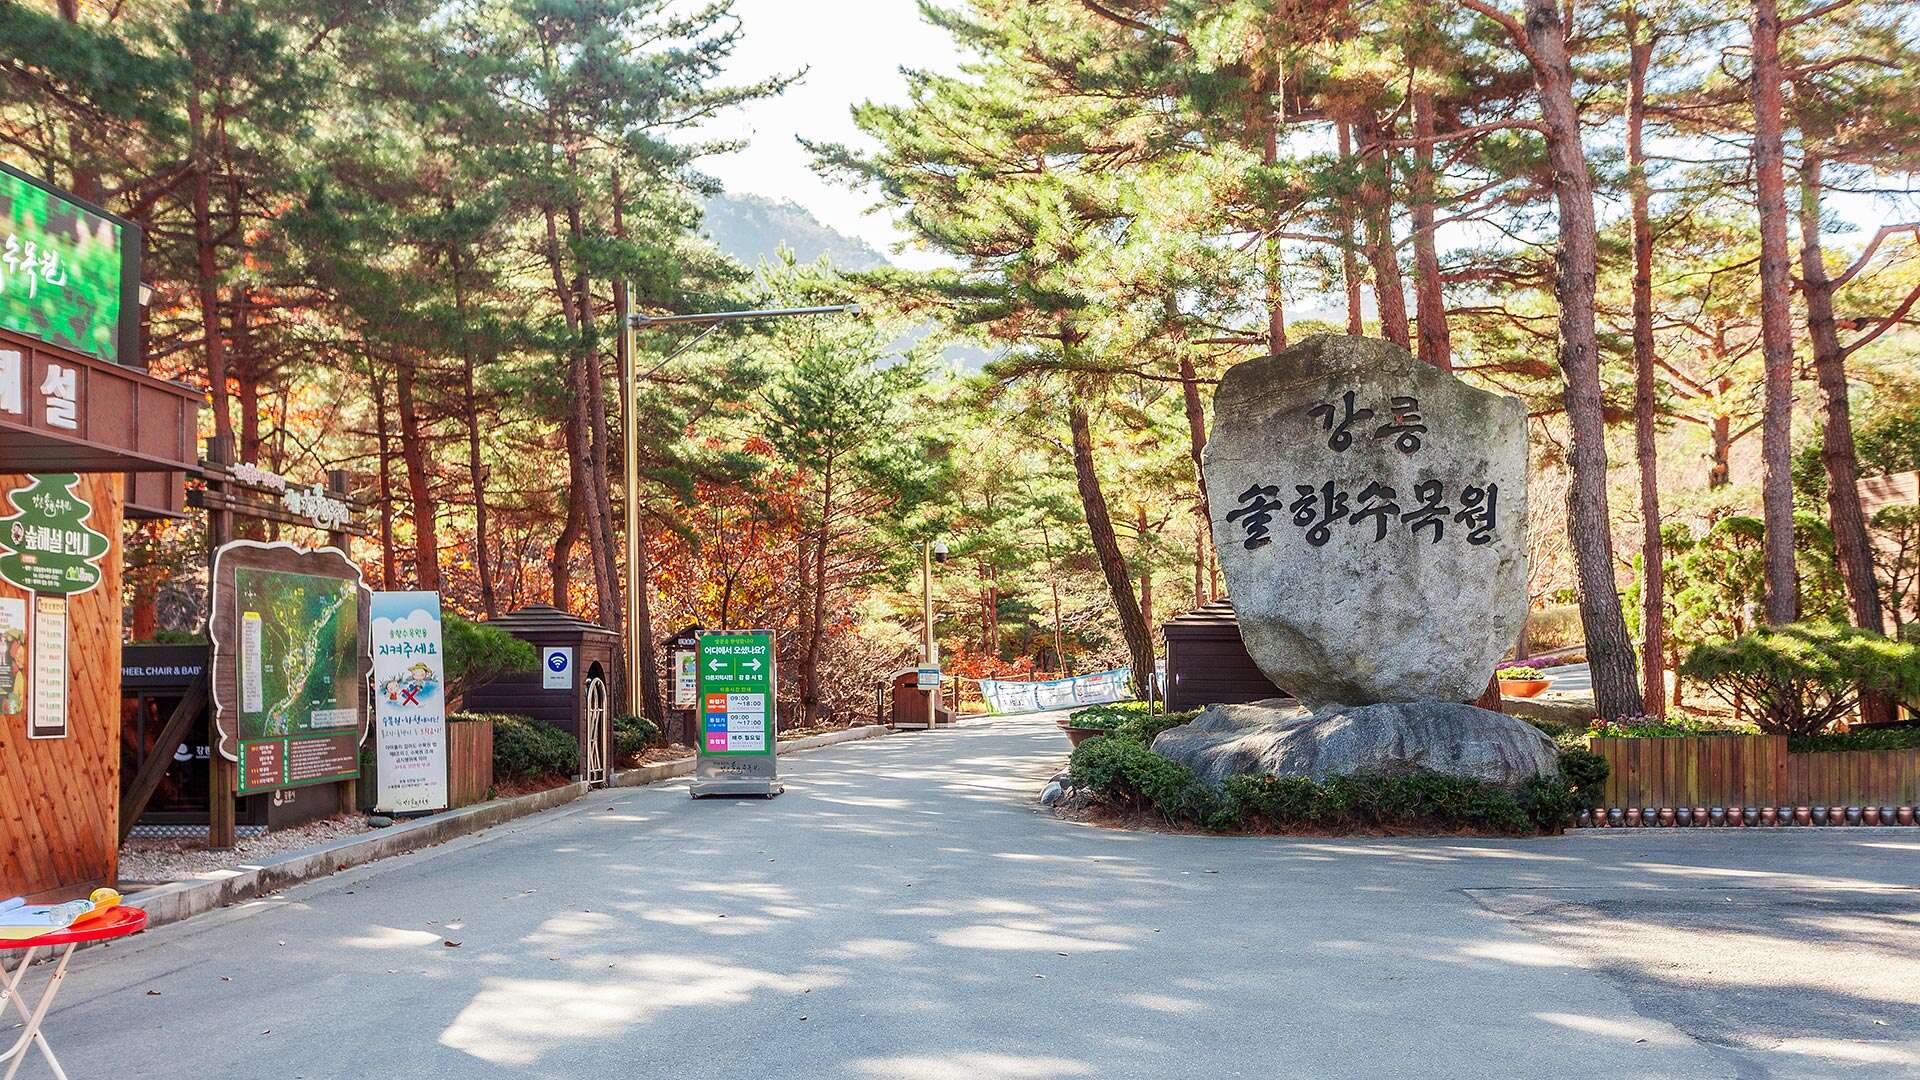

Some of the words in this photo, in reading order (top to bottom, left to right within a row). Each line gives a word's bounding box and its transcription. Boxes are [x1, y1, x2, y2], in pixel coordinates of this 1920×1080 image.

[0, 233, 67, 298] 수목원
[1307, 390, 1428, 453] 강릉
[1226, 479, 1499, 550] 솔향수목원
[25, 524, 64, 554] 숲해설
[65, 530, 89, 556] 안내
[379, 641, 437, 659] 지켜주세요
[704, 646, 732, 655] 어디에서
[734, 646, 766, 655] 오셨나요?
[121, 666, 145, 676] HEEL
[145, 666, 173, 676] CHAIR
[173, 666, 180, 675] &
[181, 666, 202, 675] BAB
